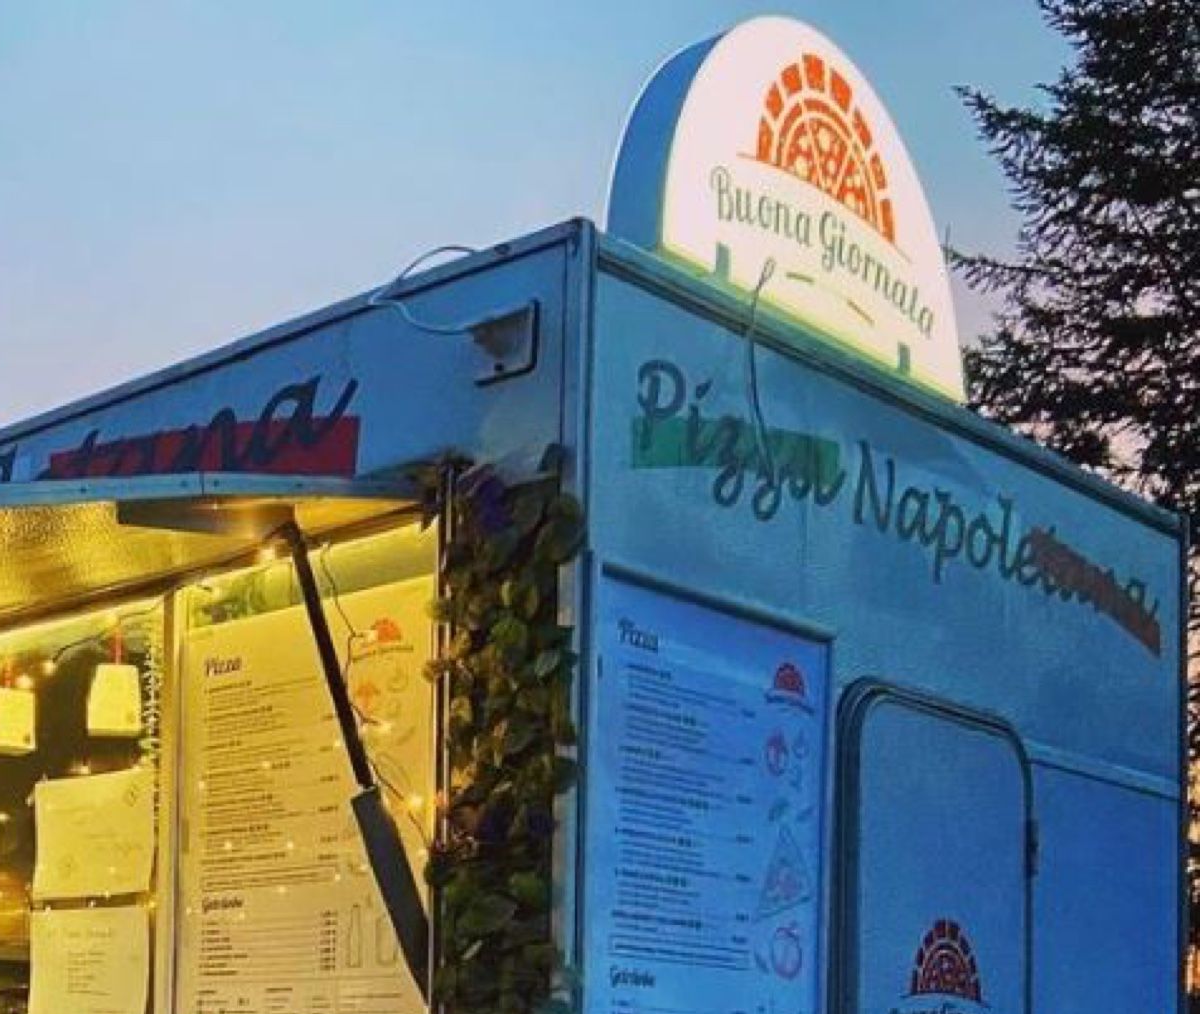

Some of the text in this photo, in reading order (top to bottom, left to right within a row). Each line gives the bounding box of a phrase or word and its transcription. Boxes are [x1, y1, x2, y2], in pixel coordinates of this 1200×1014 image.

[711, 165, 935, 341] Buona Giornata
[636, 358, 847, 521] Pizza
